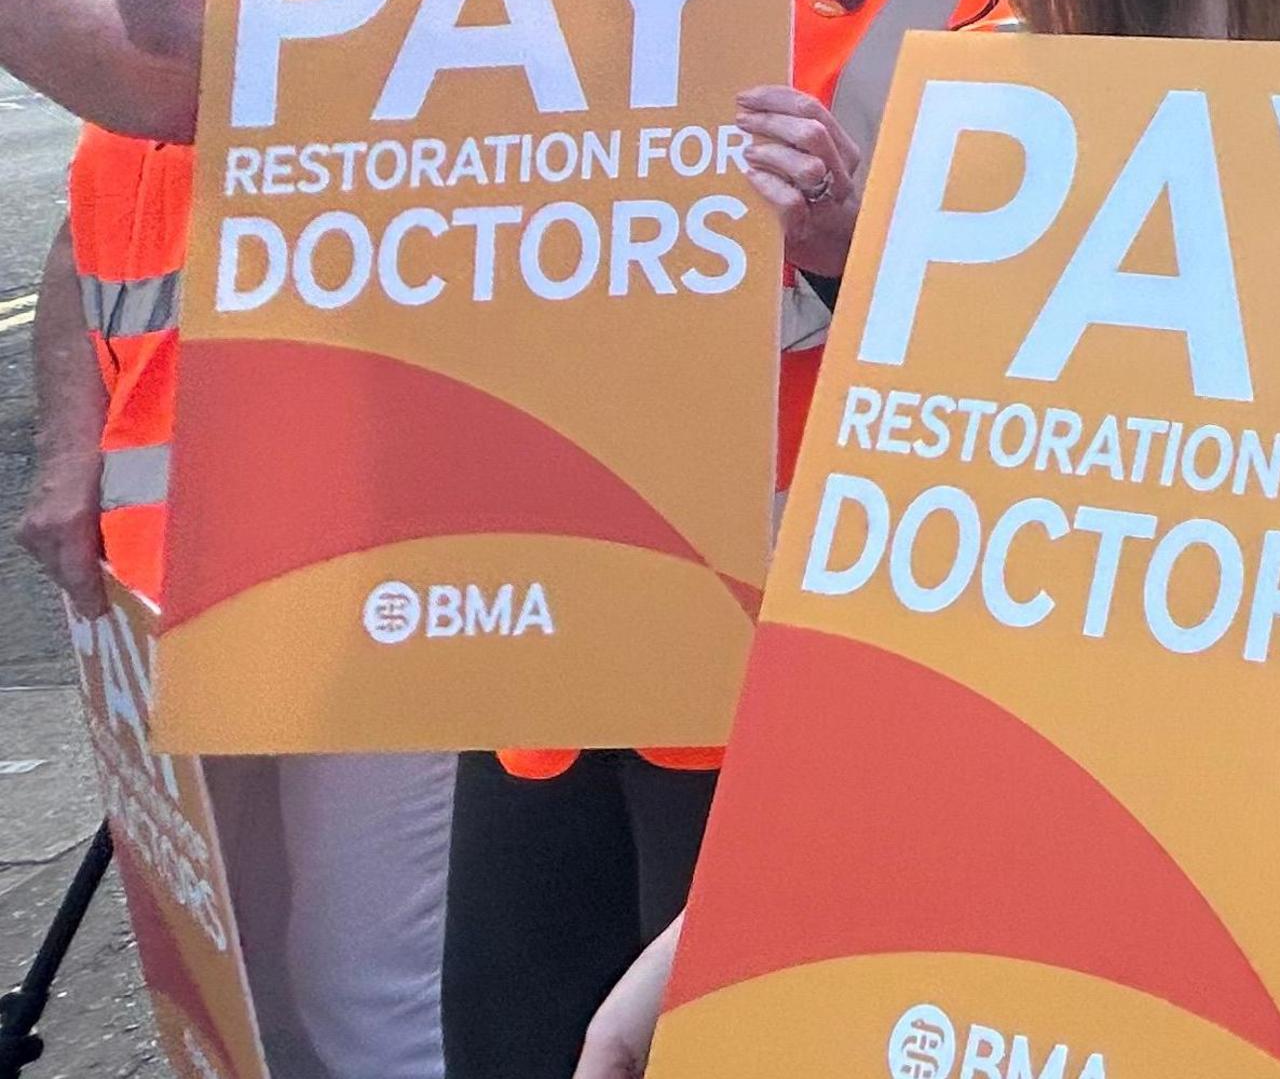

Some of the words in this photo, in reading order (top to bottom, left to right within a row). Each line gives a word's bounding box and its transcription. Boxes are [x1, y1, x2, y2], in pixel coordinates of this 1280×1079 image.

[225, 130, 620, 197] RESTORATION
[637, 125, 752, 178] FOR
[216, 195, 748, 313] DOCTORS
[427, 582, 555, 638] BMA
